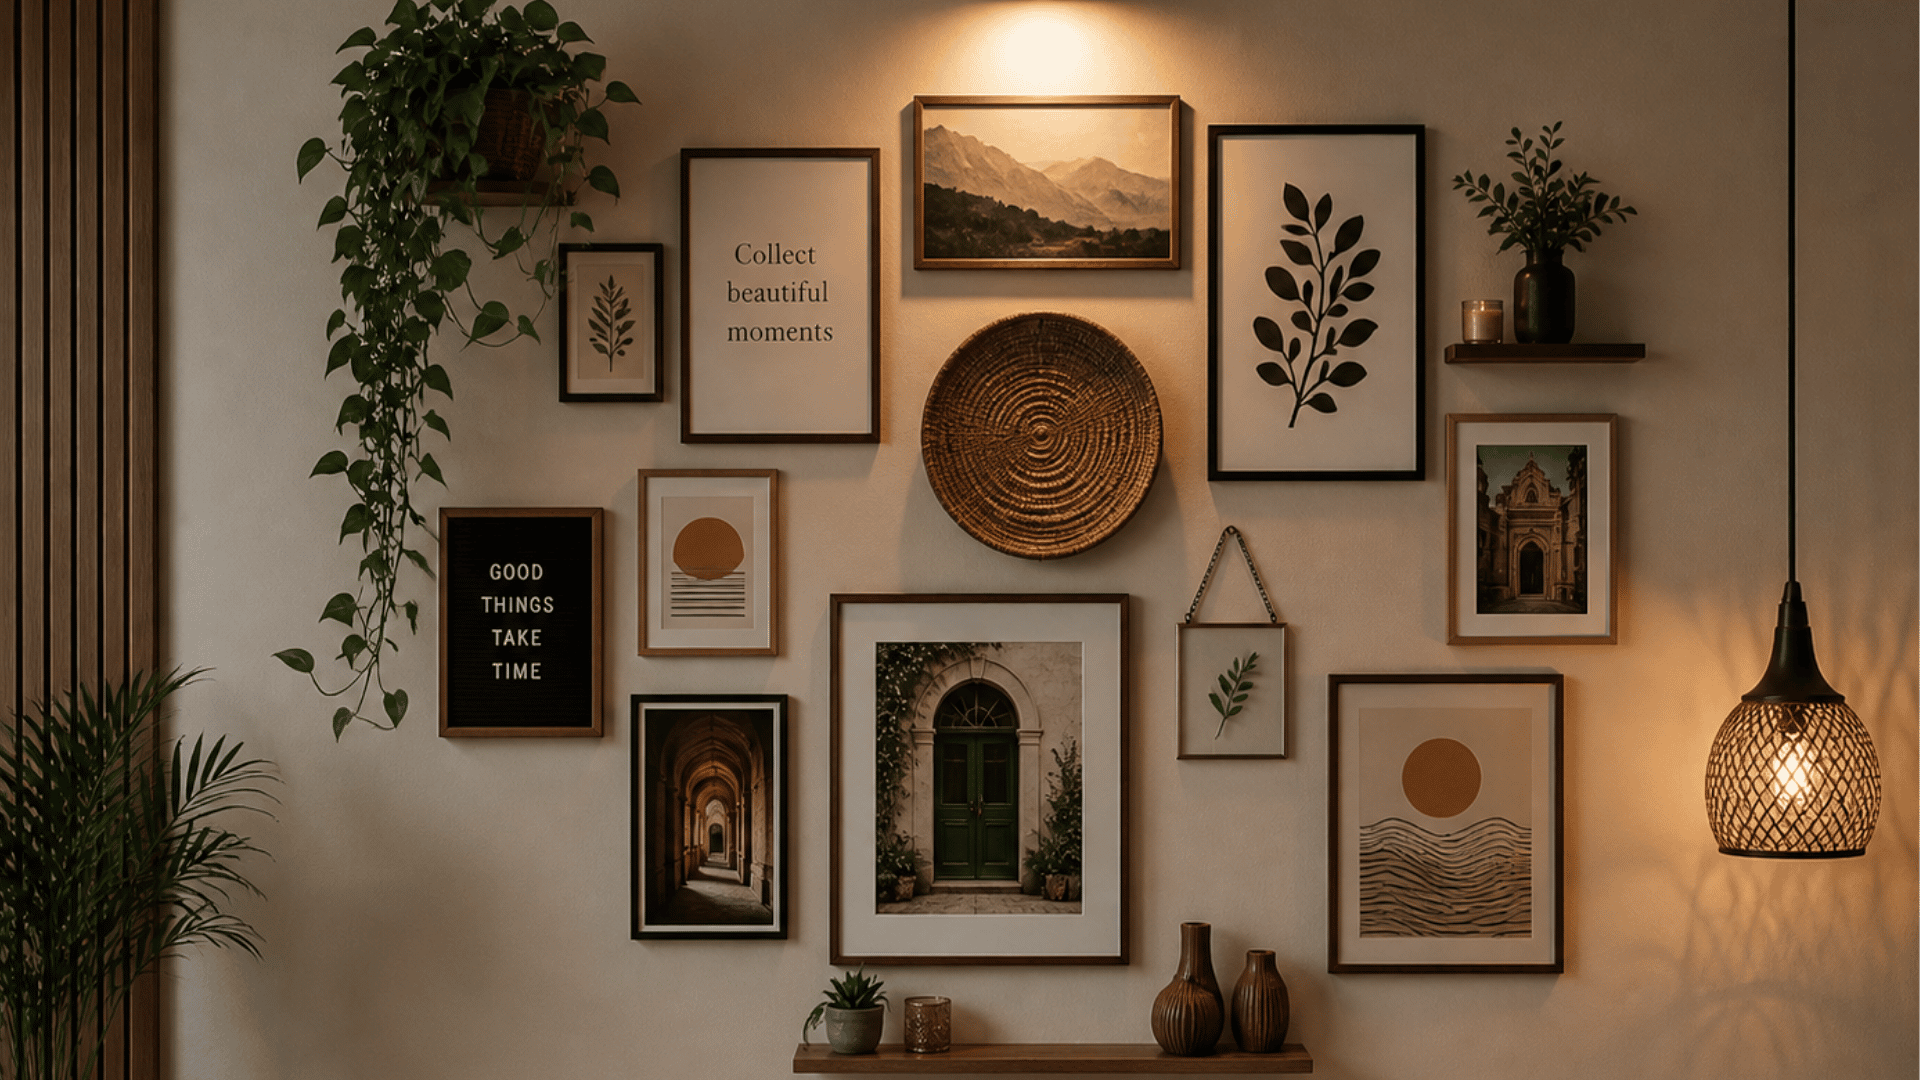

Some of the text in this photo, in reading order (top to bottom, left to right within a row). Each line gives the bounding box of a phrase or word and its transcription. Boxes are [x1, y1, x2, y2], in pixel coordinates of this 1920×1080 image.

[735, 243, 816, 265] Collect
[727, 280, 828, 303] beautiful
[727, 323, 834, 342] moments
[489, 563, 543, 580] GOOD
[481, 596, 554, 613] THINGS
[492, 629, 542, 646] TAKE
[492, 662, 542, 680] TIME
